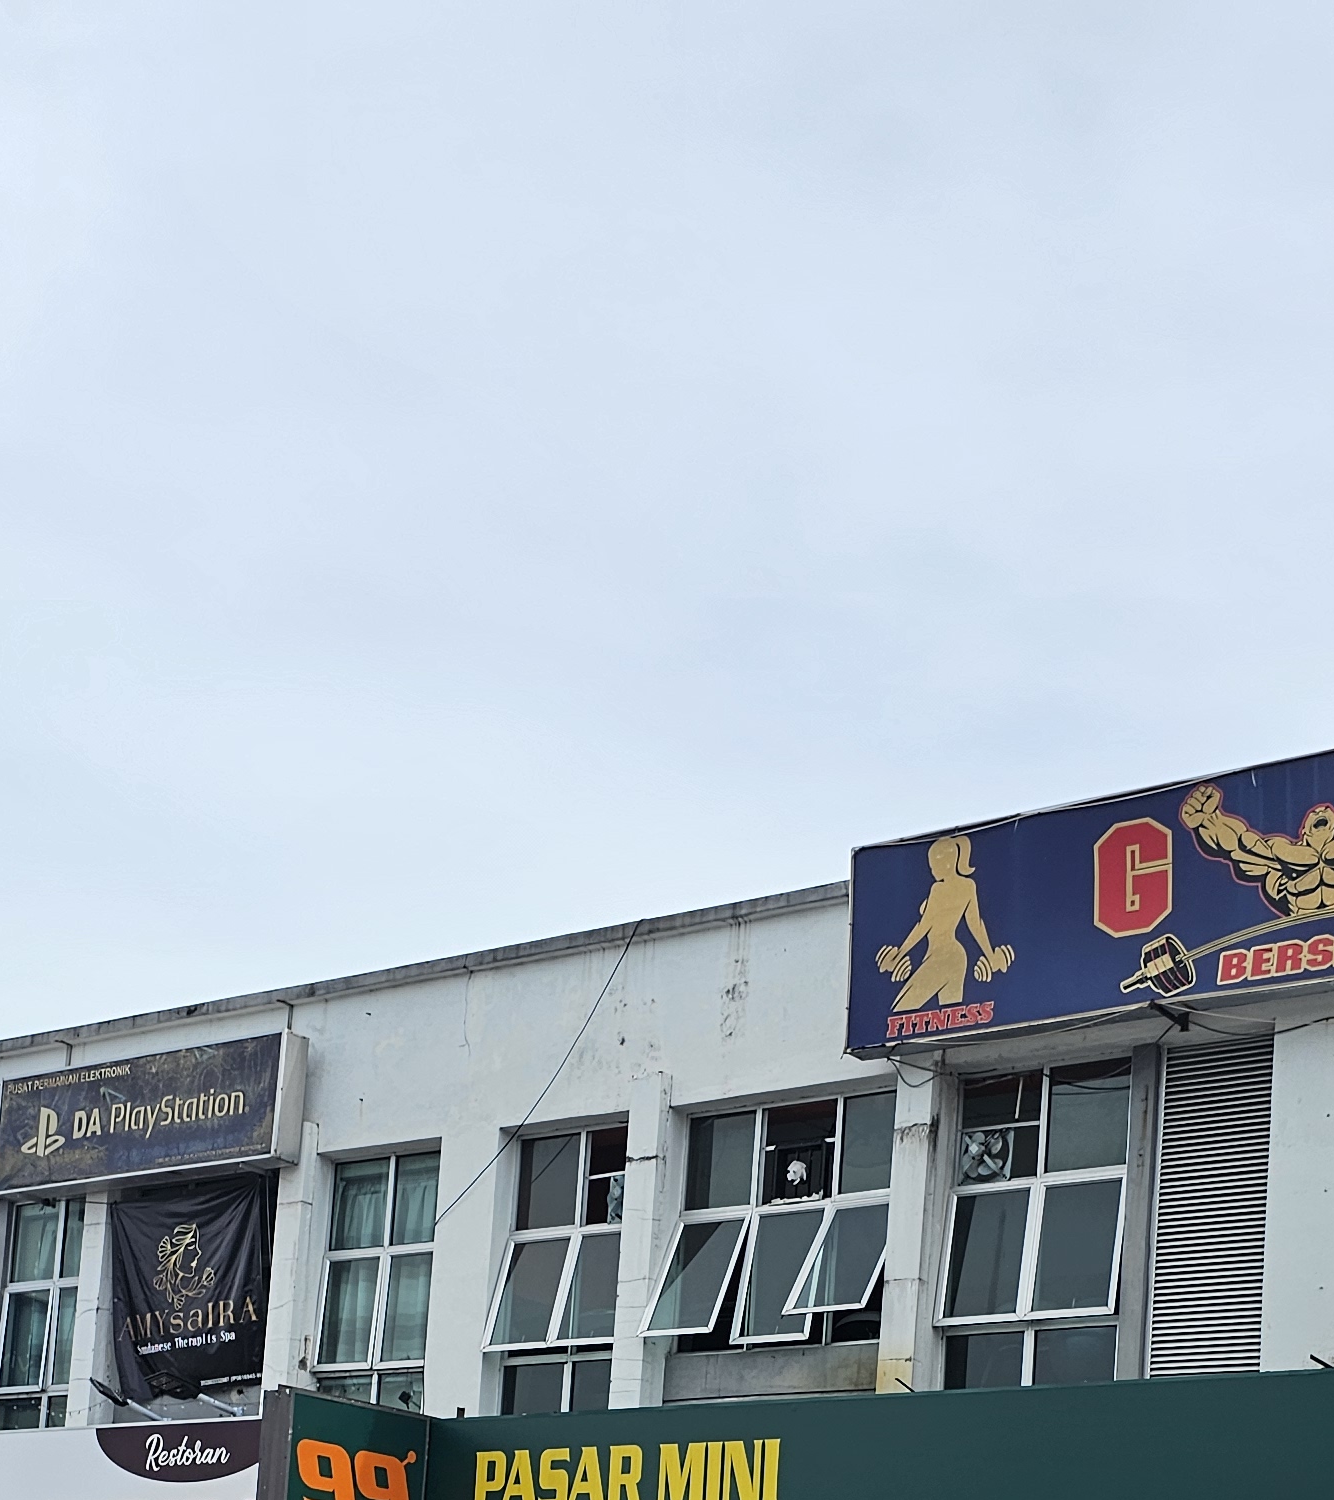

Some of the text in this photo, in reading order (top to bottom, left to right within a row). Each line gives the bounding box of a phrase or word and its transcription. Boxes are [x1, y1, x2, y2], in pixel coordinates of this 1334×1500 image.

[1093, 818, 1173, 936] G
[887, 1001, 994, 1038] FITNESS
[7, 1081, 32, 1095] PUSAT
[80, 1064, 131, 1082] ELEKTRONIK
[72, 1089, 245, 1140] DA PlayStation
[220, 1330, 236, 1343] Spa
[144, 1433, 230, 1473] Restoran
